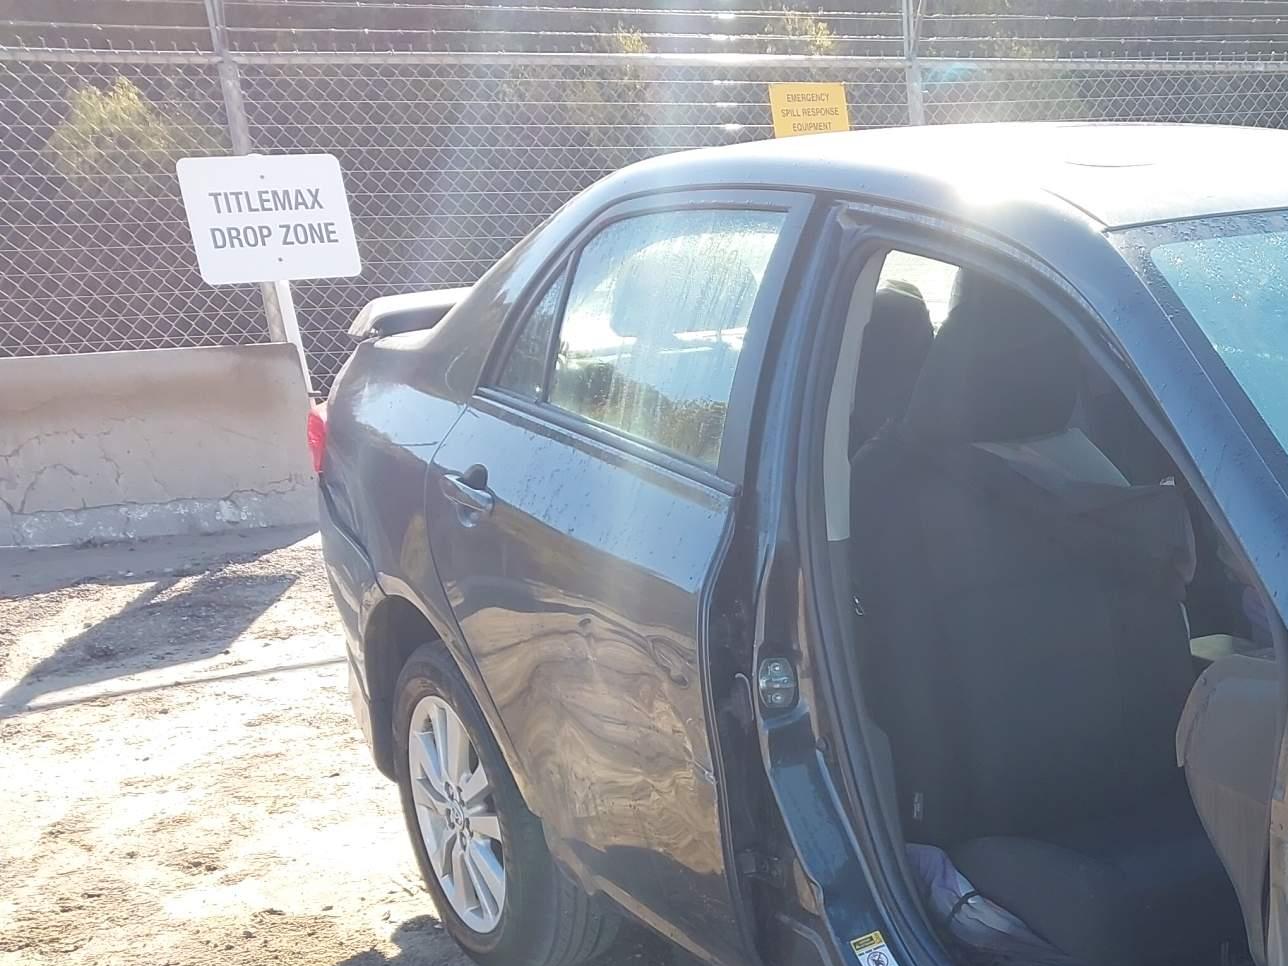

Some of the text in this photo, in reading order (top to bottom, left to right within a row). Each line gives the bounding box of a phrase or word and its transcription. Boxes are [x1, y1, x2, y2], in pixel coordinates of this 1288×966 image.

[786, 93, 829, 103] EMERGENCY
[780, 106, 840, 118] SPILL RESPONSE
[792, 121, 832, 132] EQUIPMENT
[208, 188, 325, 214] TITLEMAX
[210, 222, 339, 249] DROP ZONE
